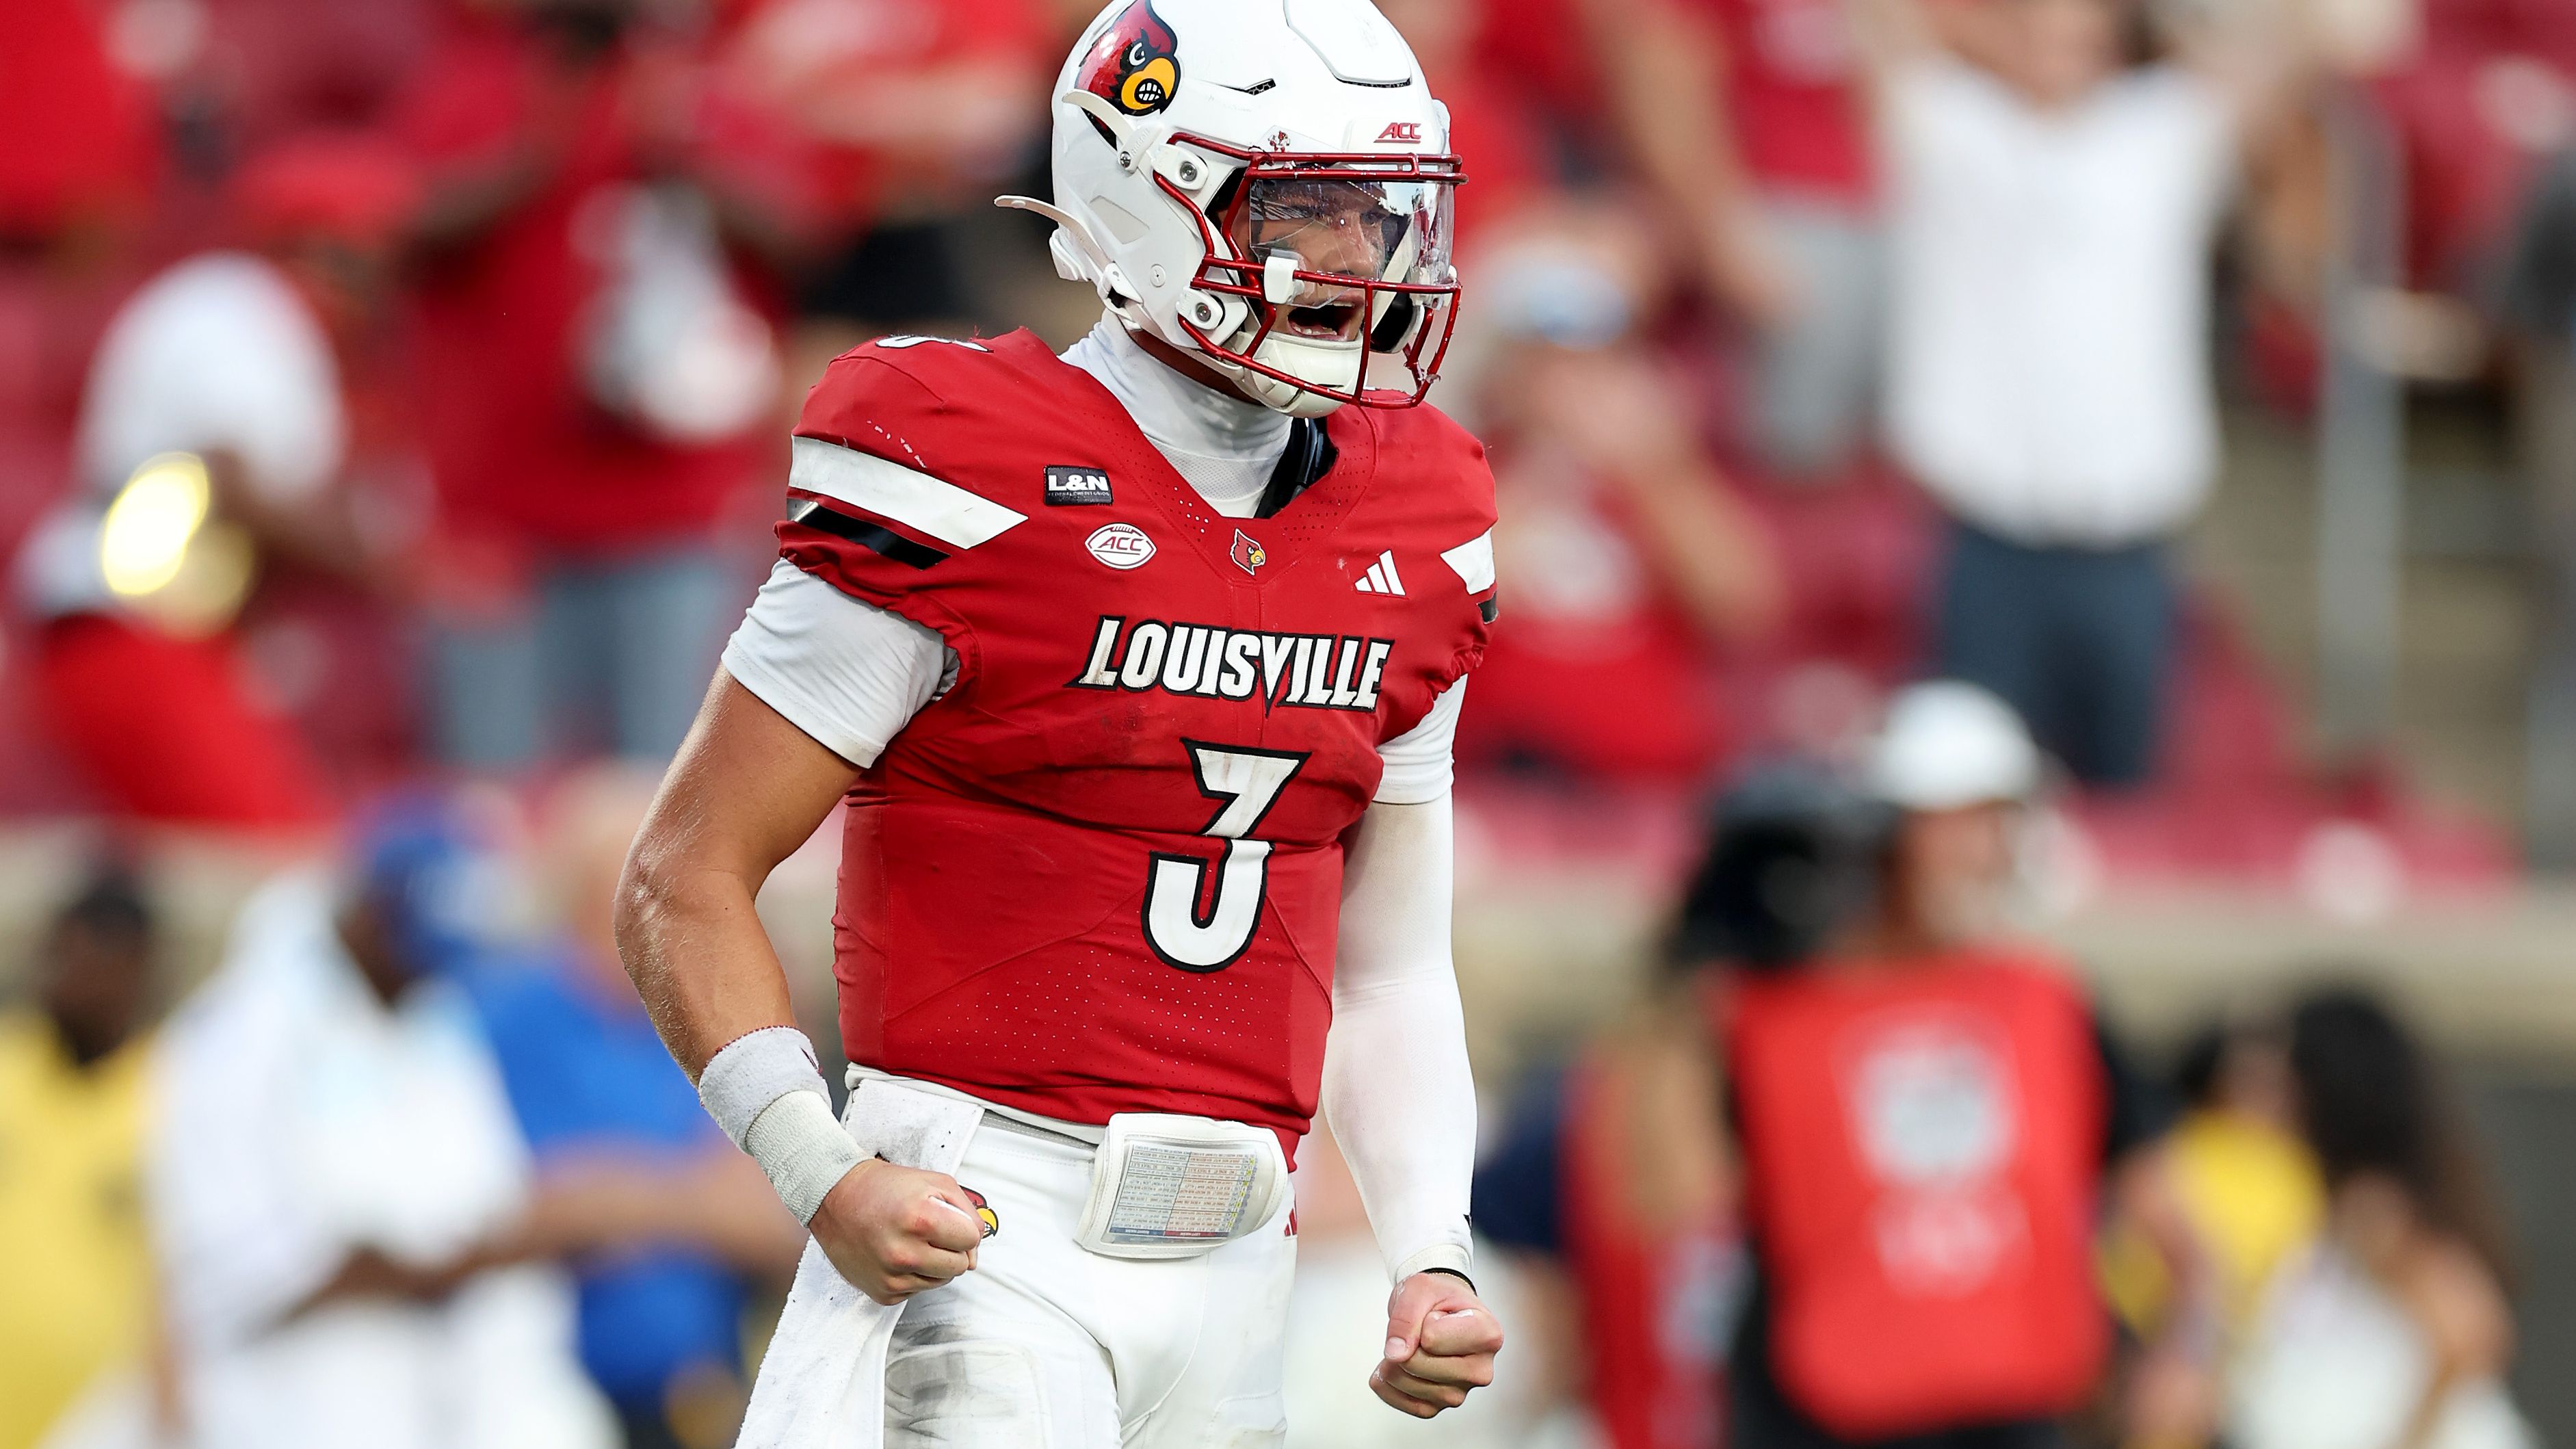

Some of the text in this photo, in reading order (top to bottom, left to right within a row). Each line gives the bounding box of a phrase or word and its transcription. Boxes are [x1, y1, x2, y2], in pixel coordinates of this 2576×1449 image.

[1378, 122, 1421, 139] ACC
[1049, 474, 1109, 491] L&N
[1098, 536, 1144, 552] ACC
[1074, 615, 1393, 713] LOUISVILLE
[1142, 739, 1311, 972] 3
